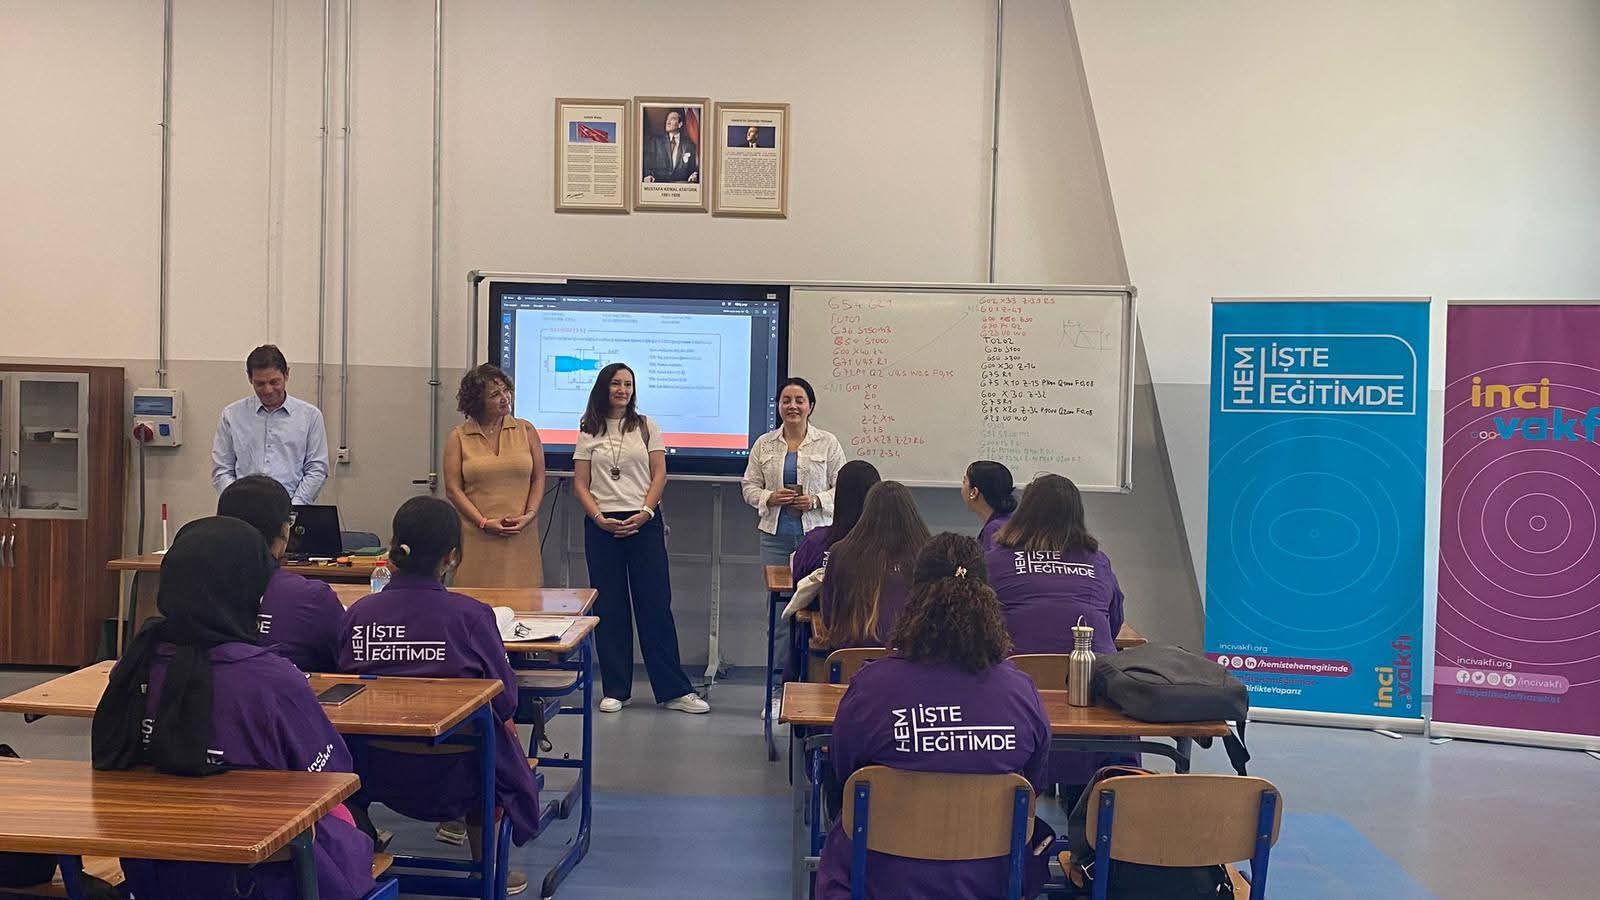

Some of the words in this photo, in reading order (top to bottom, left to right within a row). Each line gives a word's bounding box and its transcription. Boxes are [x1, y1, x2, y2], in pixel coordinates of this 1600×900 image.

[1271, 342, 1329, 373] İŞTE
[1233, 347, 1255, 404] HEM
[1270, 379, 1404, 406] EĞİTİMDE
[1471, 376, 1550, 409] inci
[1494, 406, 1600, 442] vakf
[1014, 550, 1027, 575] HEM
[1034, 563, 1096, 578] EĞİTİMDE
[352, 625, 364, 661] HEM
[372, 622, 405, 641] İŞTE
[371, 645, 445, 661] EĞİTİMDE
[1374, 666, 1394, 708] inci
[918, 703, 962, 727] İŞTE
[891, 708, 911, 753] HEM
[922, 731, 1016, 752] EĞİTİMDE
